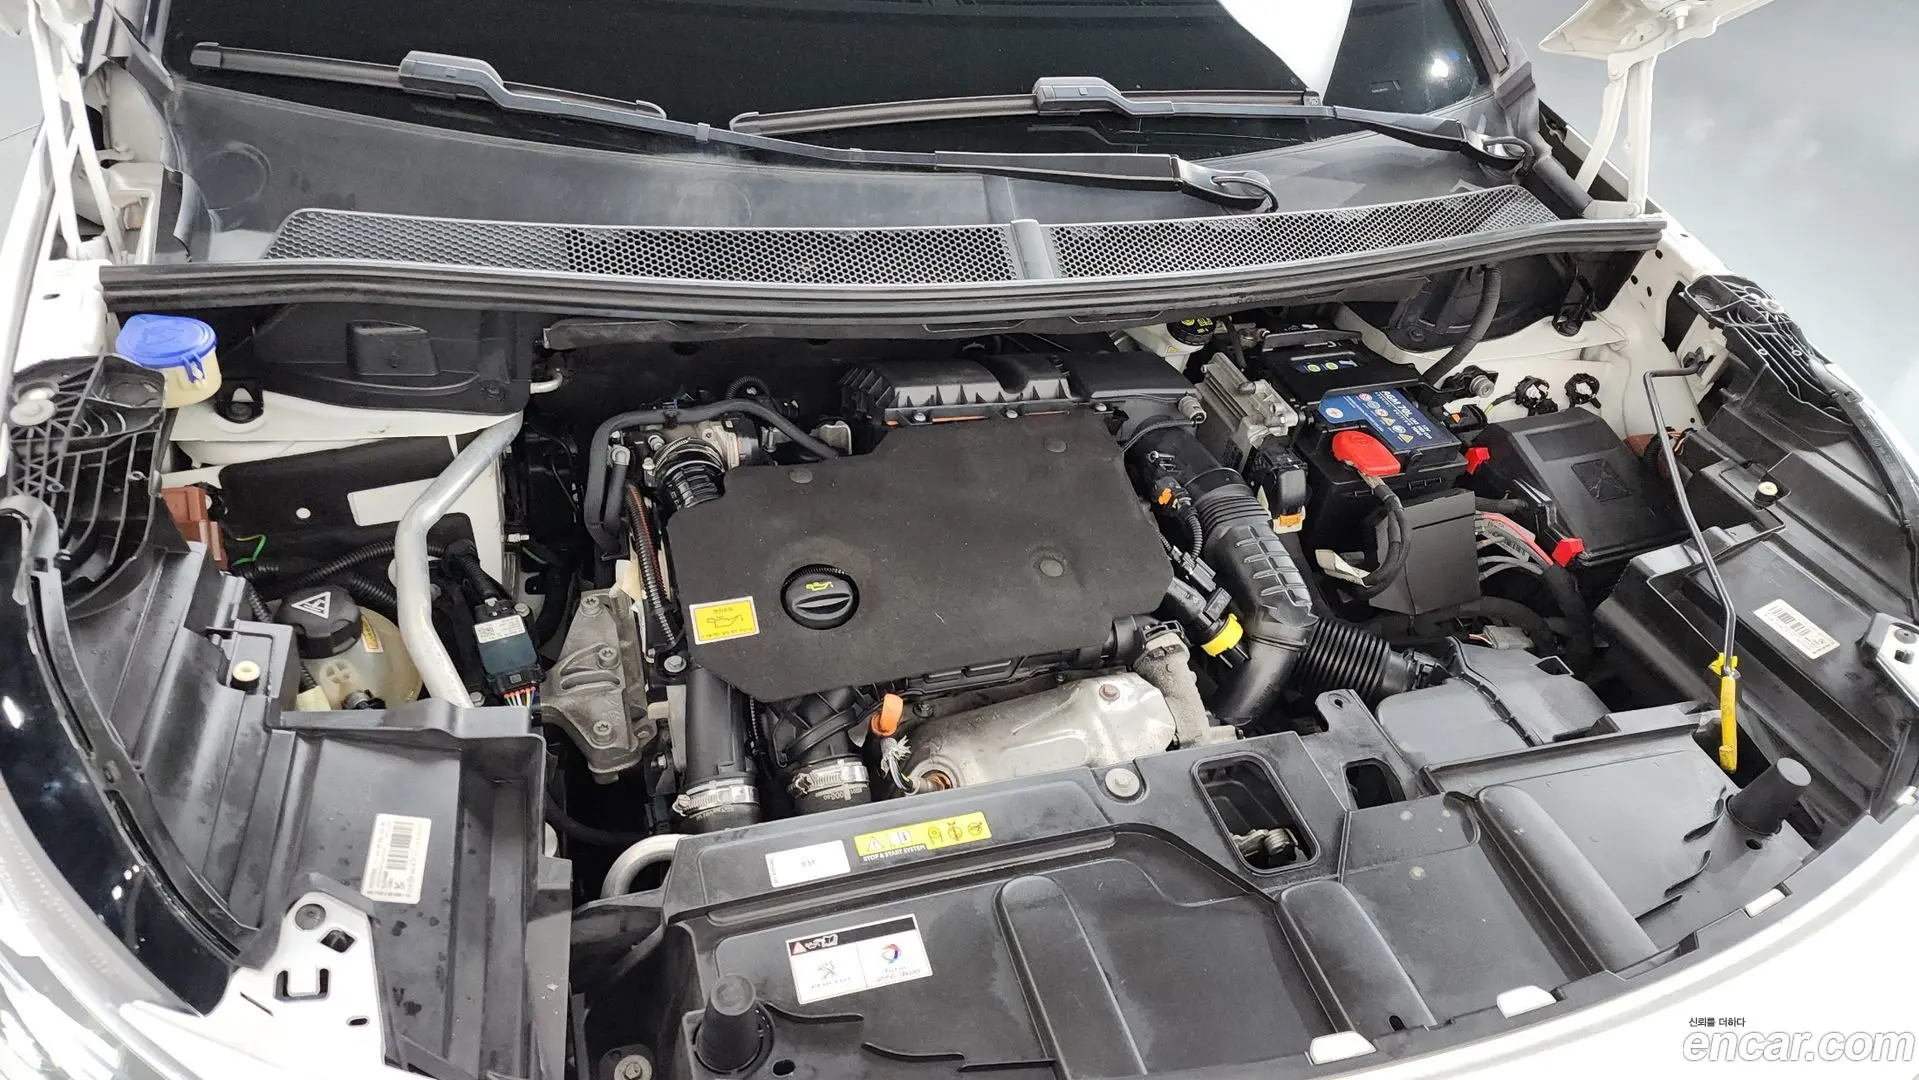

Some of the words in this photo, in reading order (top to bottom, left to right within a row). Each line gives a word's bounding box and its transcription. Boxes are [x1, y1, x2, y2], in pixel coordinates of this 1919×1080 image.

[1381, 391, 1401, 405] AGM
[1398, 404, 1413, 417] 70L
[863, 853, 879, 862] STOP
[884, 849, 903, 858] START
[903, 844, 926, 855] SYSTEM
